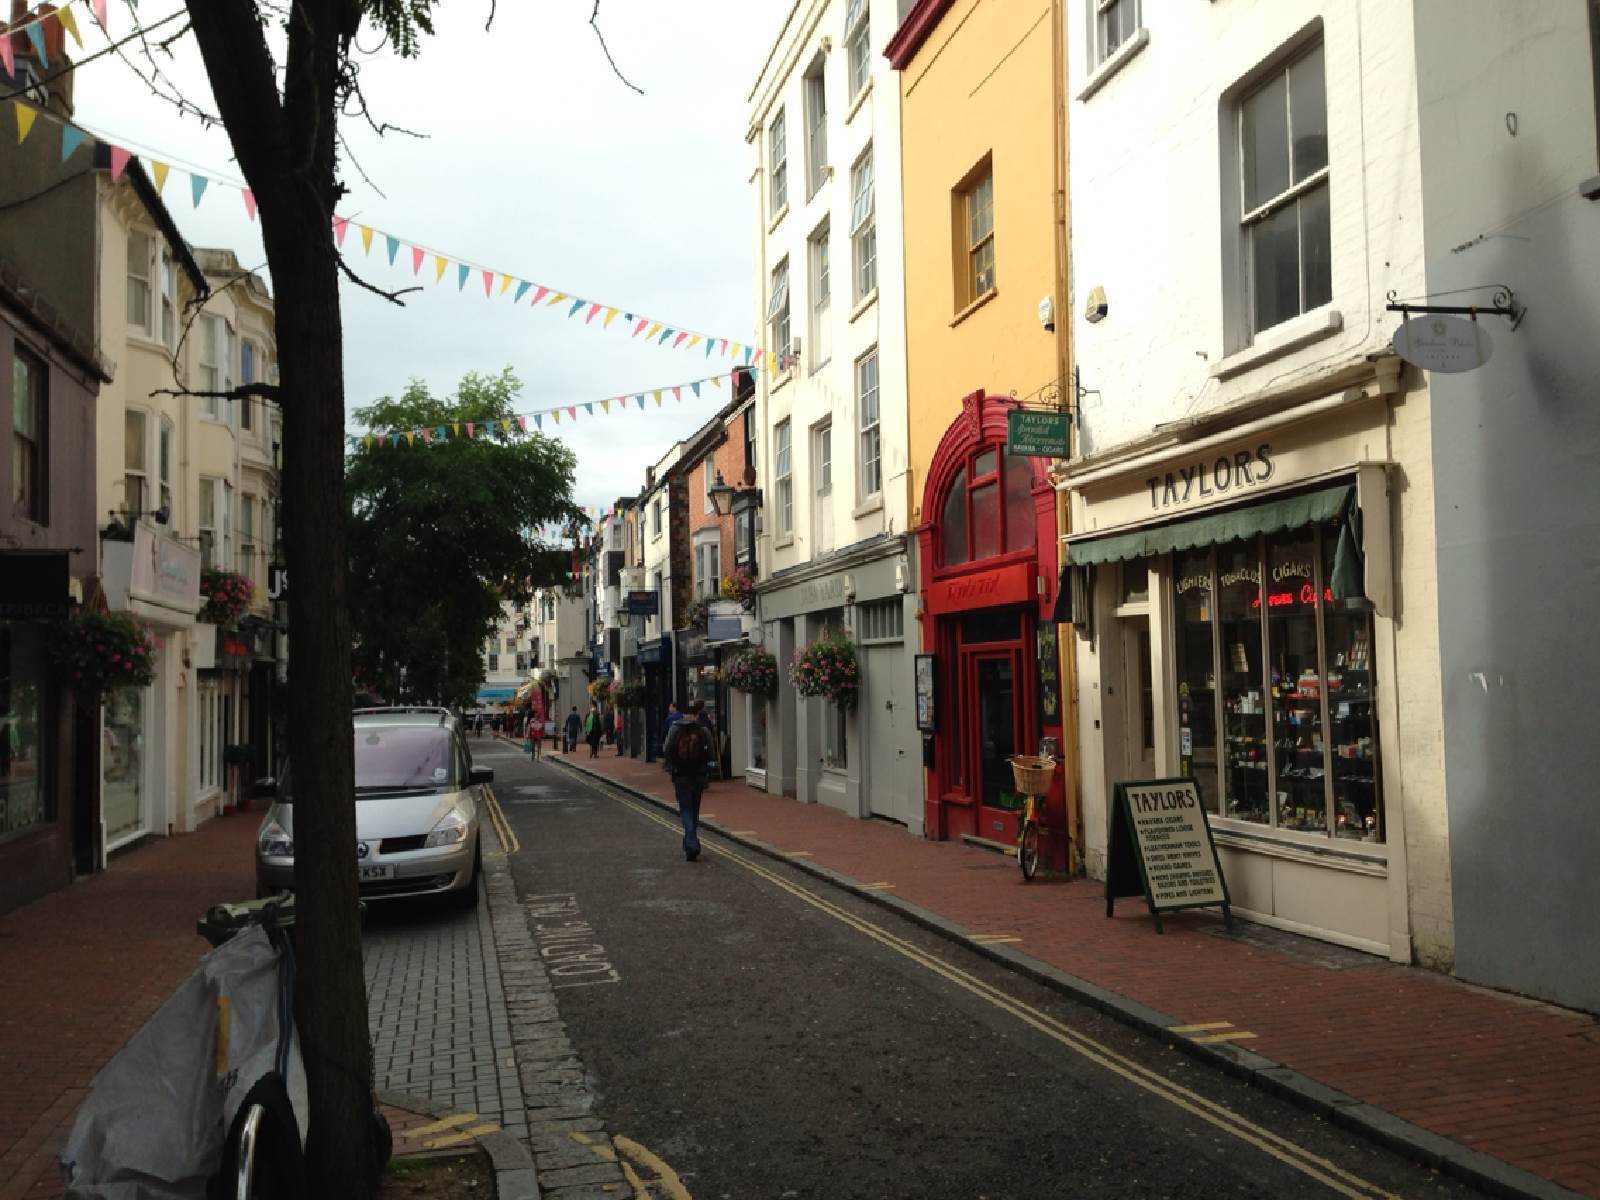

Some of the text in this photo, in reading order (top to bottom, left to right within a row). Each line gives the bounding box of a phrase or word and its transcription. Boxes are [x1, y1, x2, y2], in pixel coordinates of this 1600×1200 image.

[1021, 413, 1060, 425] TAYLORS
[1146, 443, 1276, 511] TAYLORS
[1272, 561, 1311, 582] CIGARS
[1132, 789, 1195, 813] TAYLORS
